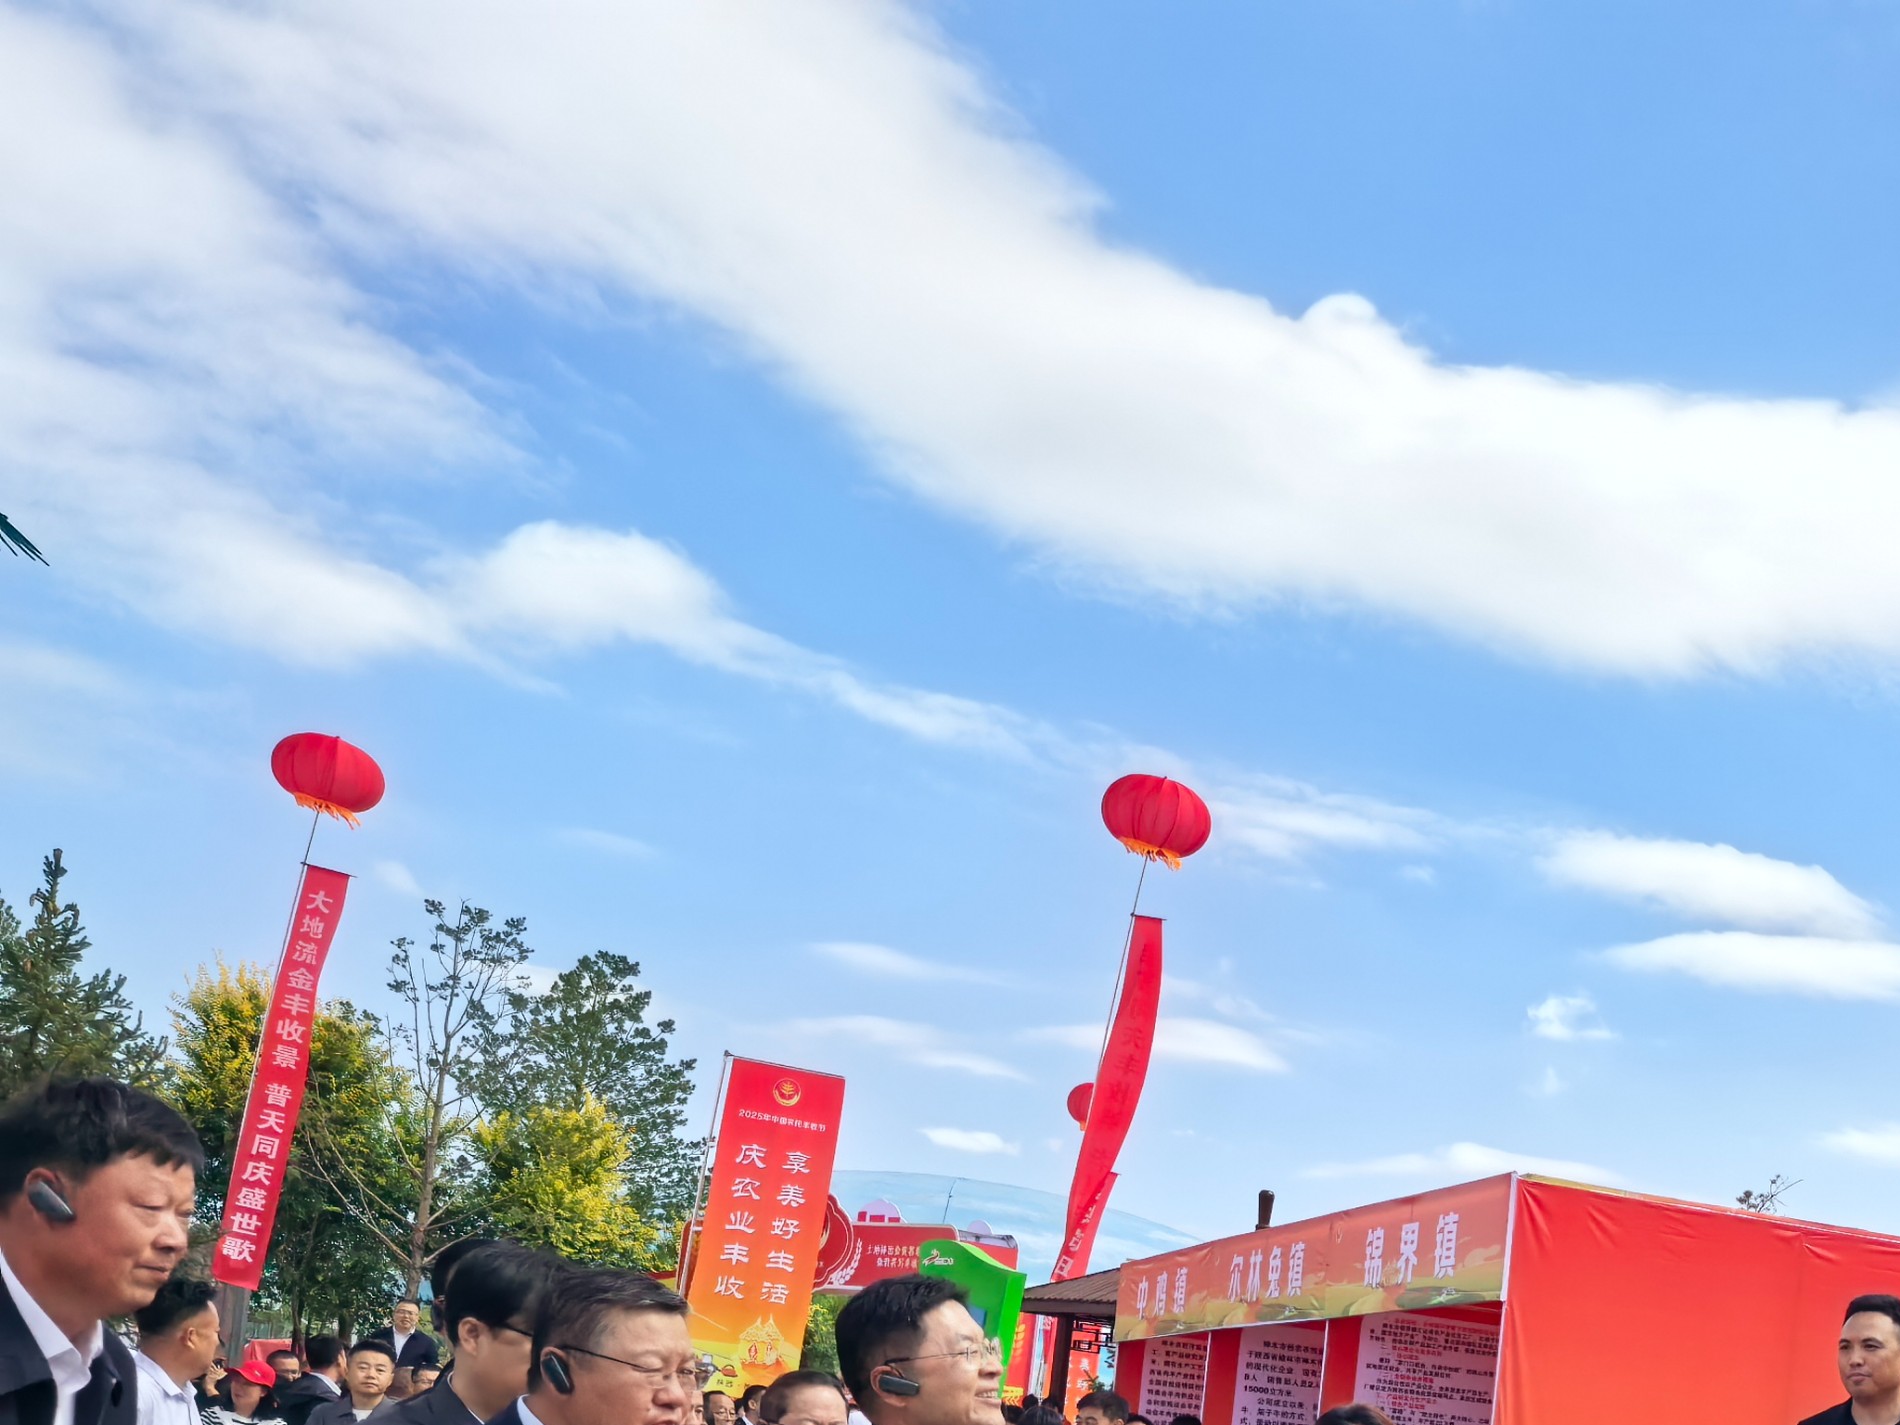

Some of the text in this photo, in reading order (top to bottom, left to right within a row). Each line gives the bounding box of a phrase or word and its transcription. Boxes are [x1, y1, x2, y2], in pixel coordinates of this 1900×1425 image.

[221, 889, 335, 1266] 大地流金丰收景 普天同庆盛世歌
[714, 1142, 767, 1300] 庆农业丰收
[761, 1150, 812, 1305] 享美好生活
[1228, 1242, 1306, 1304] 尔林兔镇
[1364, 1212, 1460, 1289] 锦界镇
[1135, 1266, 1189, 1320] 中鸡镇
